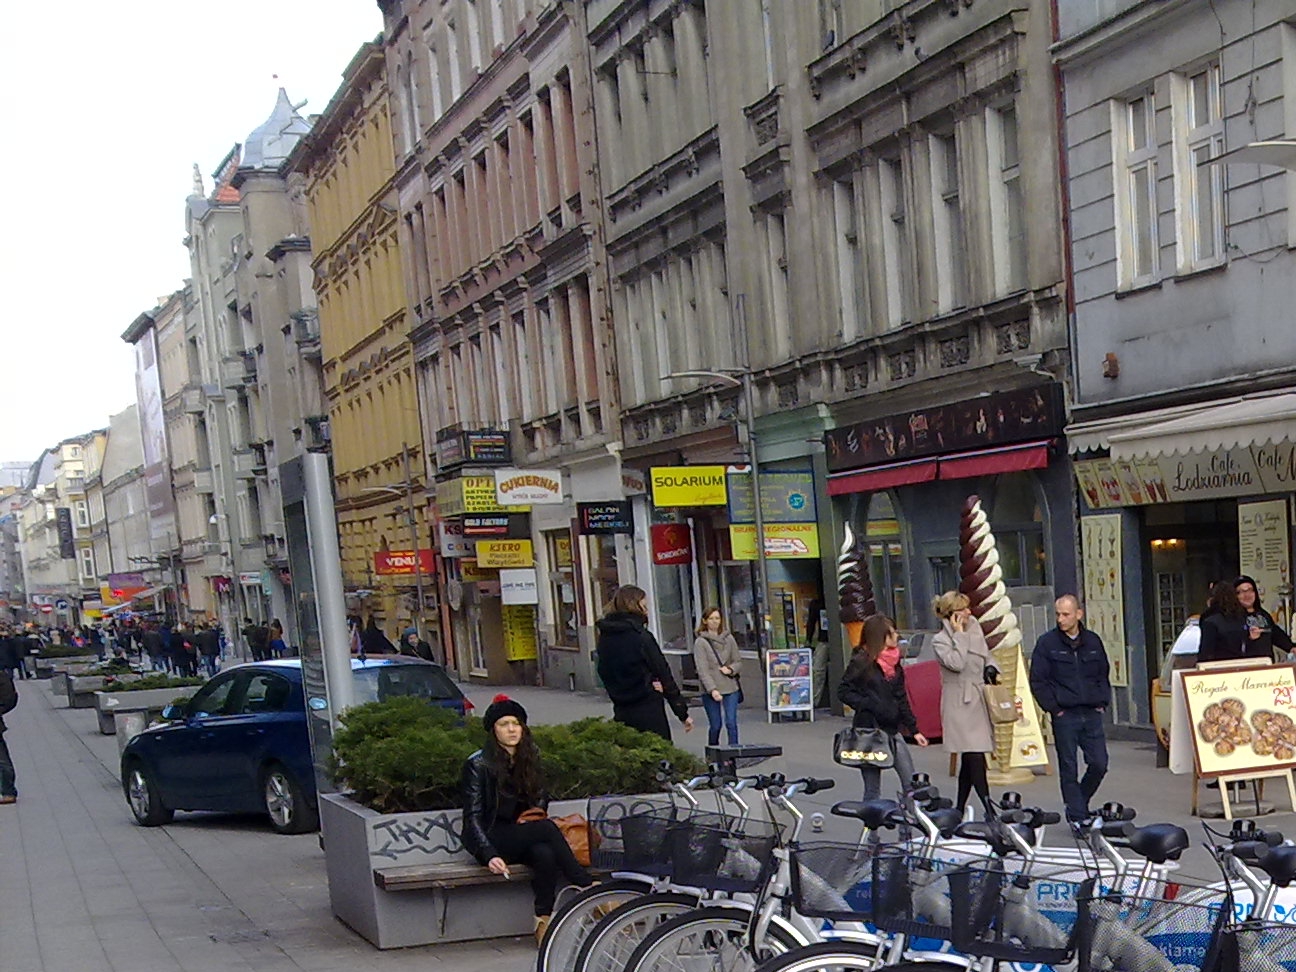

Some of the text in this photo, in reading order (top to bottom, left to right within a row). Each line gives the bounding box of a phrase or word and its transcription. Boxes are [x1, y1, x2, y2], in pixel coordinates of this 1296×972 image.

[1211, 454, 1235, 475] Cafe
[1257, 449, 1282, 470] Cafe
[466, 478, 494, 488] OPT
[499, 475, 559, 494] CUKIERNIA
[654, 475, 723, 488] SOLARIUM
[1172, 461, 1252, 492] Lodziarnia
